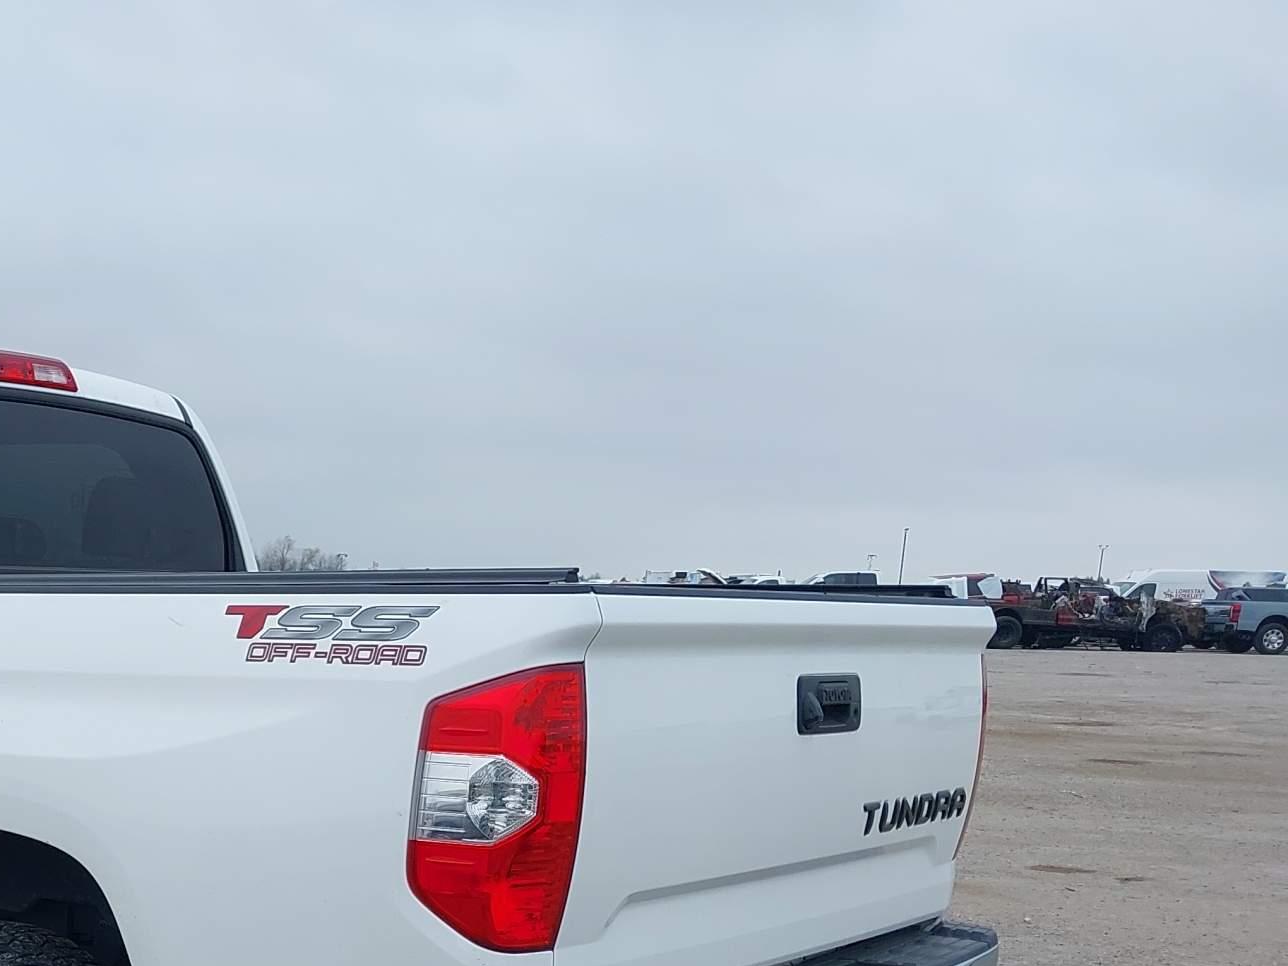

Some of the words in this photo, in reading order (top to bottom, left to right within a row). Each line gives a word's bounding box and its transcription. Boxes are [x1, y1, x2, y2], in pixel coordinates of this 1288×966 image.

[224, 604, 441, 642] TSS
[246, 642, 428, 667] OFF-ROAD
[863, 787, 967, 836] TUNDRA
